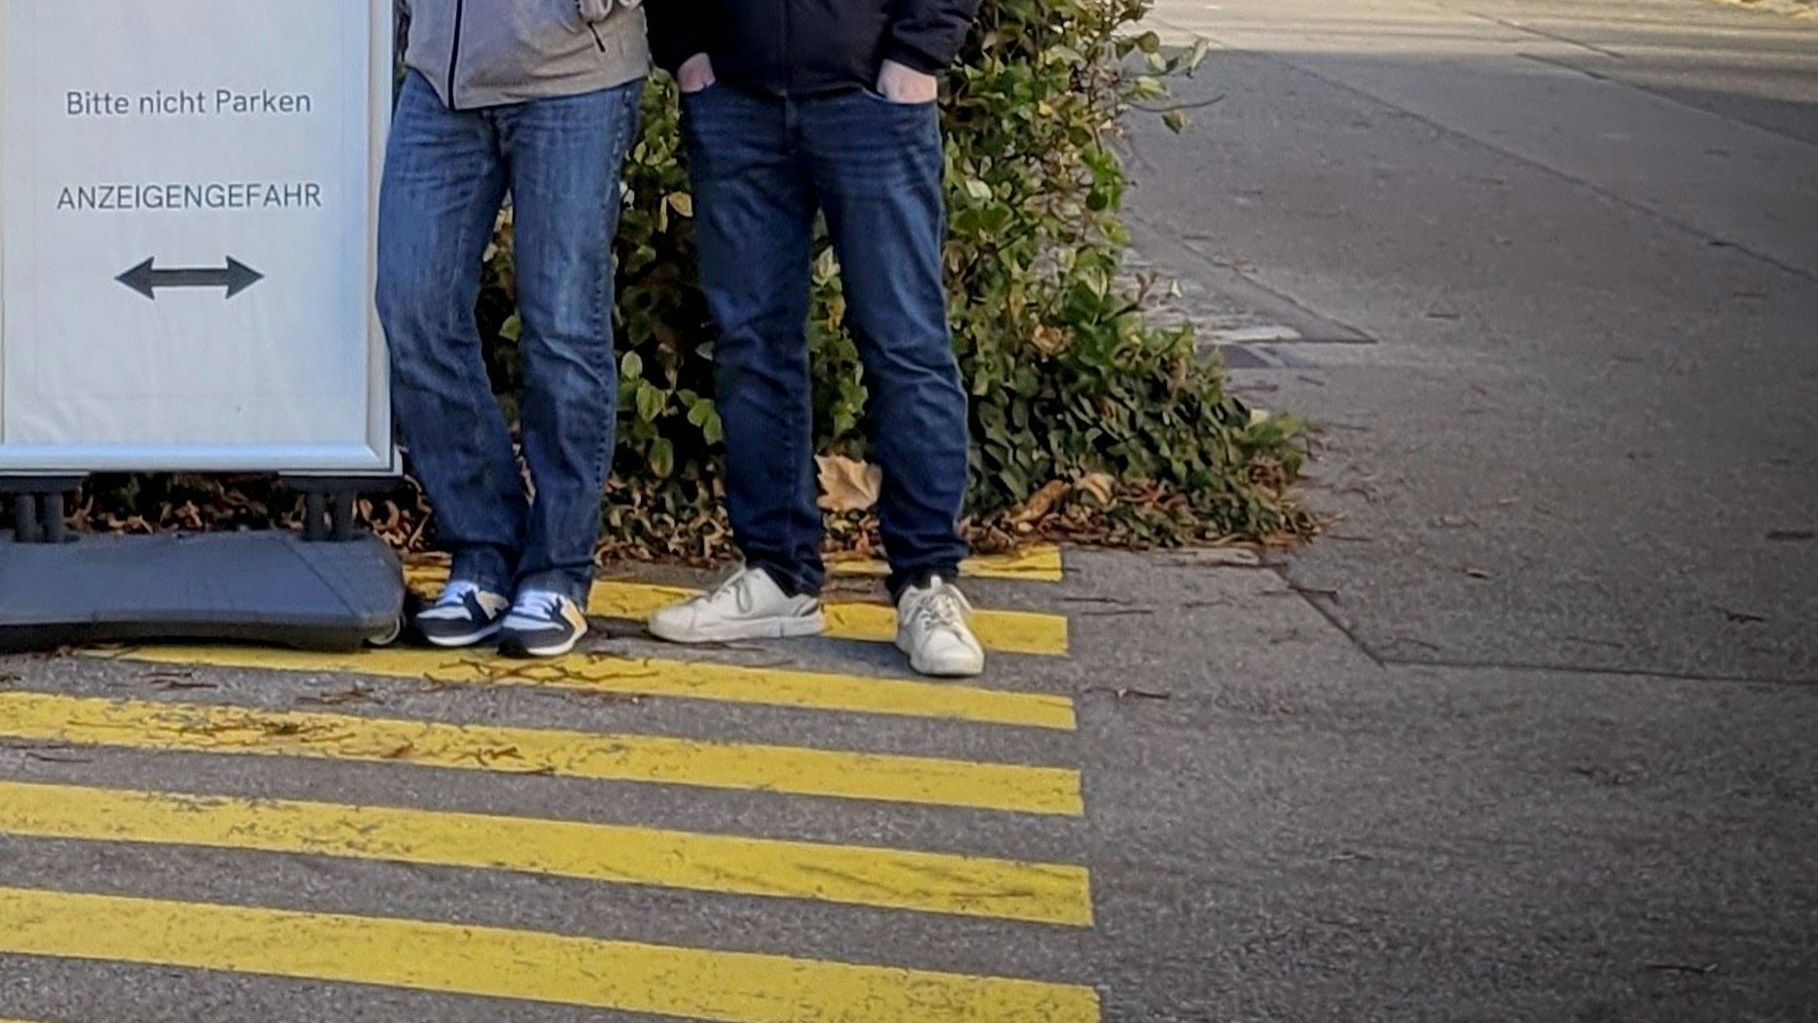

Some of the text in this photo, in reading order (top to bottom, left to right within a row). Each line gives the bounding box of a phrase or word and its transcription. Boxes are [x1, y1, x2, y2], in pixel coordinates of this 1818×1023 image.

[66, 88, 311, 115] Bitte nicht Parken
[57, 183, 322, 210] ANZEIGENGEFAHR
